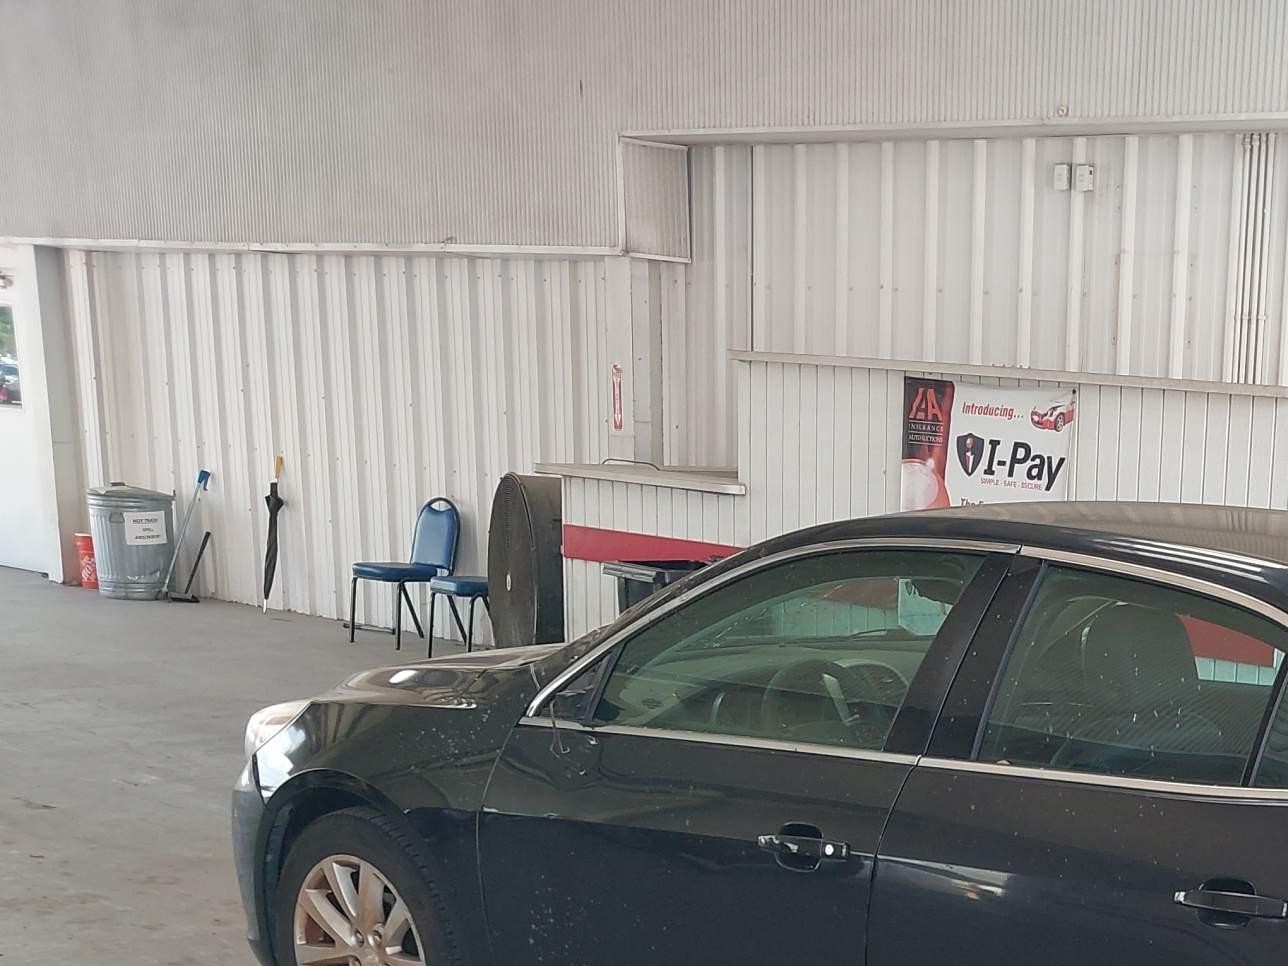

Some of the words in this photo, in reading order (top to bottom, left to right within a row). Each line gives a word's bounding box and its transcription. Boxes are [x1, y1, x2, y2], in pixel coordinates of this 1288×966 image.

[962, 402, 1024, 420] Introducing...
[983, 440, 1066, 491] I-Pay
[980, 478, 999, 486] SIMPLE
[1003, 480, 1017, 488] SAFE
[1021, 482, 1043, 490] SECURE
